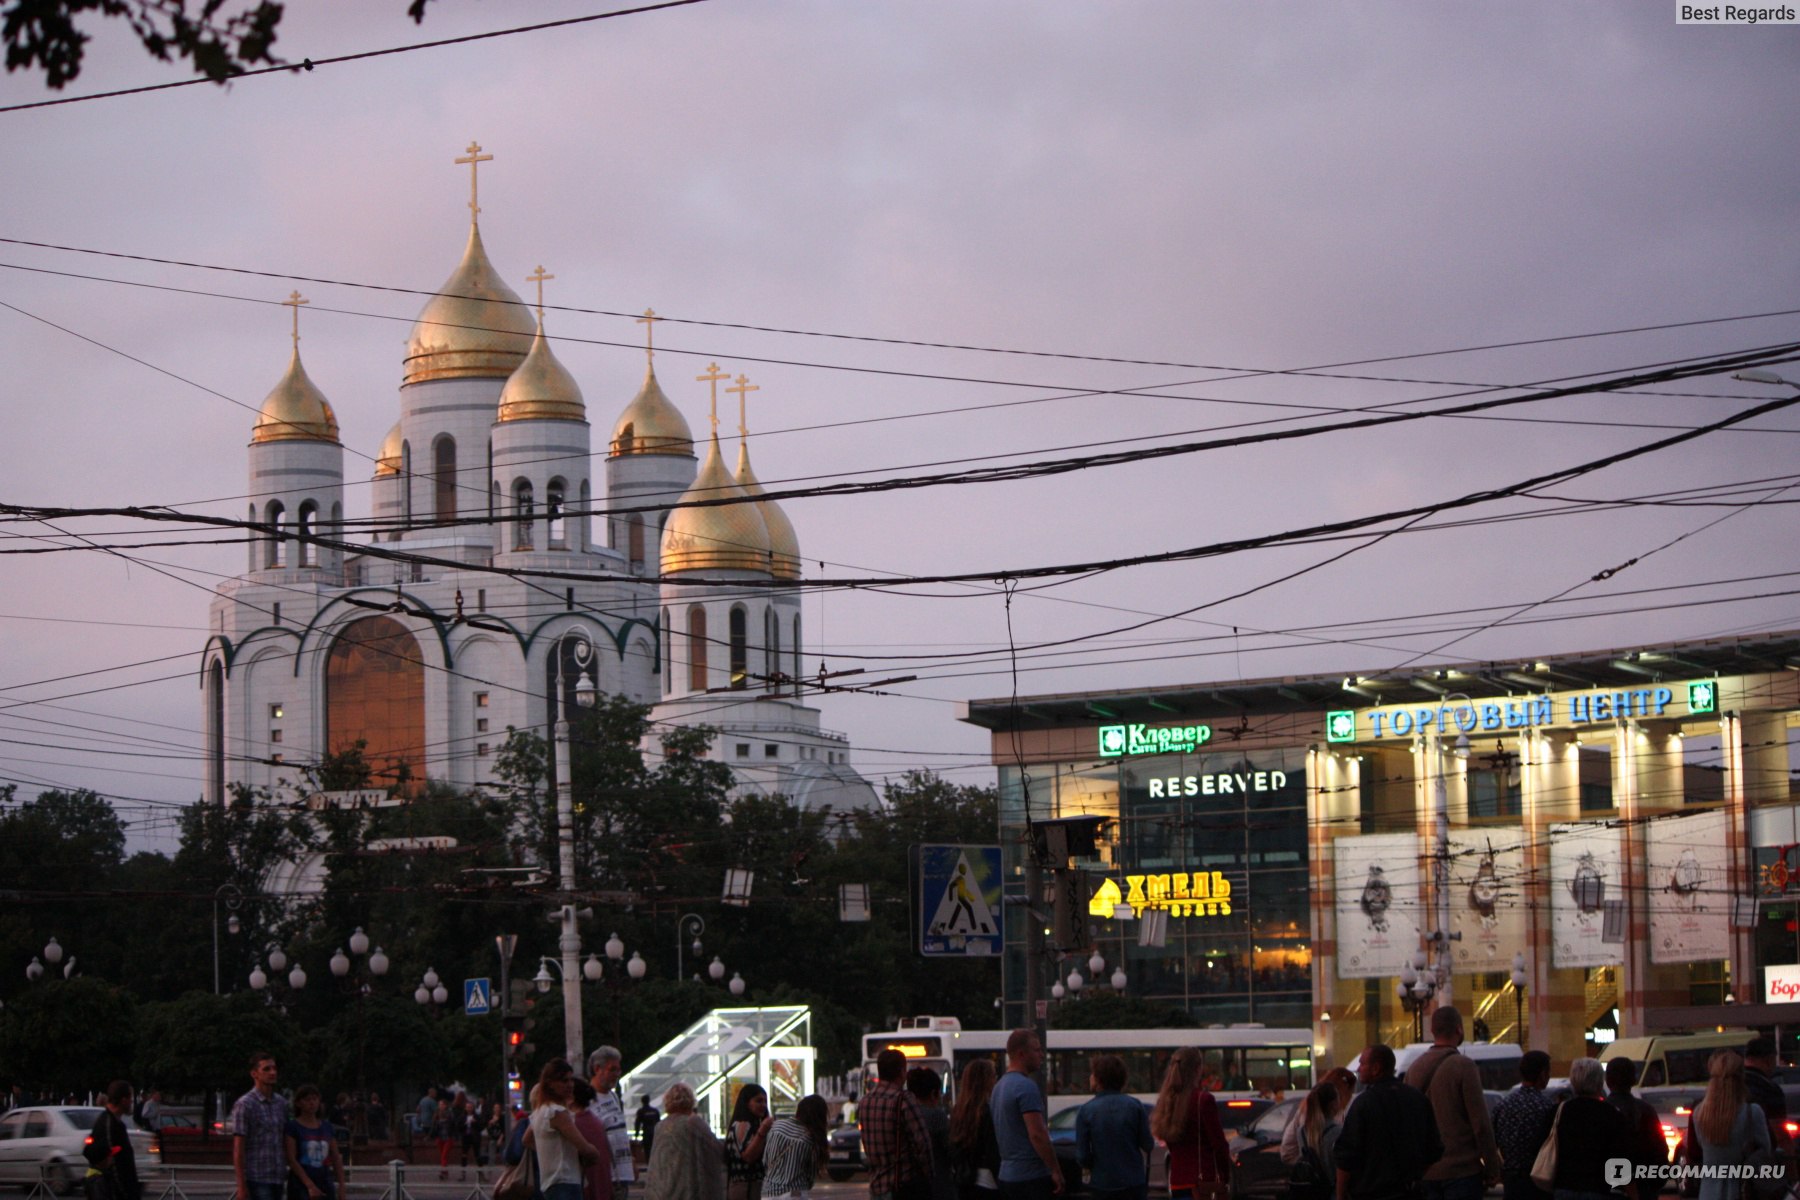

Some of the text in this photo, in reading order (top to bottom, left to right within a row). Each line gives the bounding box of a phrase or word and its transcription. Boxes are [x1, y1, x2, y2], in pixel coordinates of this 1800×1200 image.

[1368, 687, 1672, 738] ТОРГОВЫЙ ЦЕНТР
[1128, 723, 1211, 744] Кловер
[1149, 770, 1287, 798] RESERVED
[1126, 871, 1231, 902] ХМЕЛЬ
